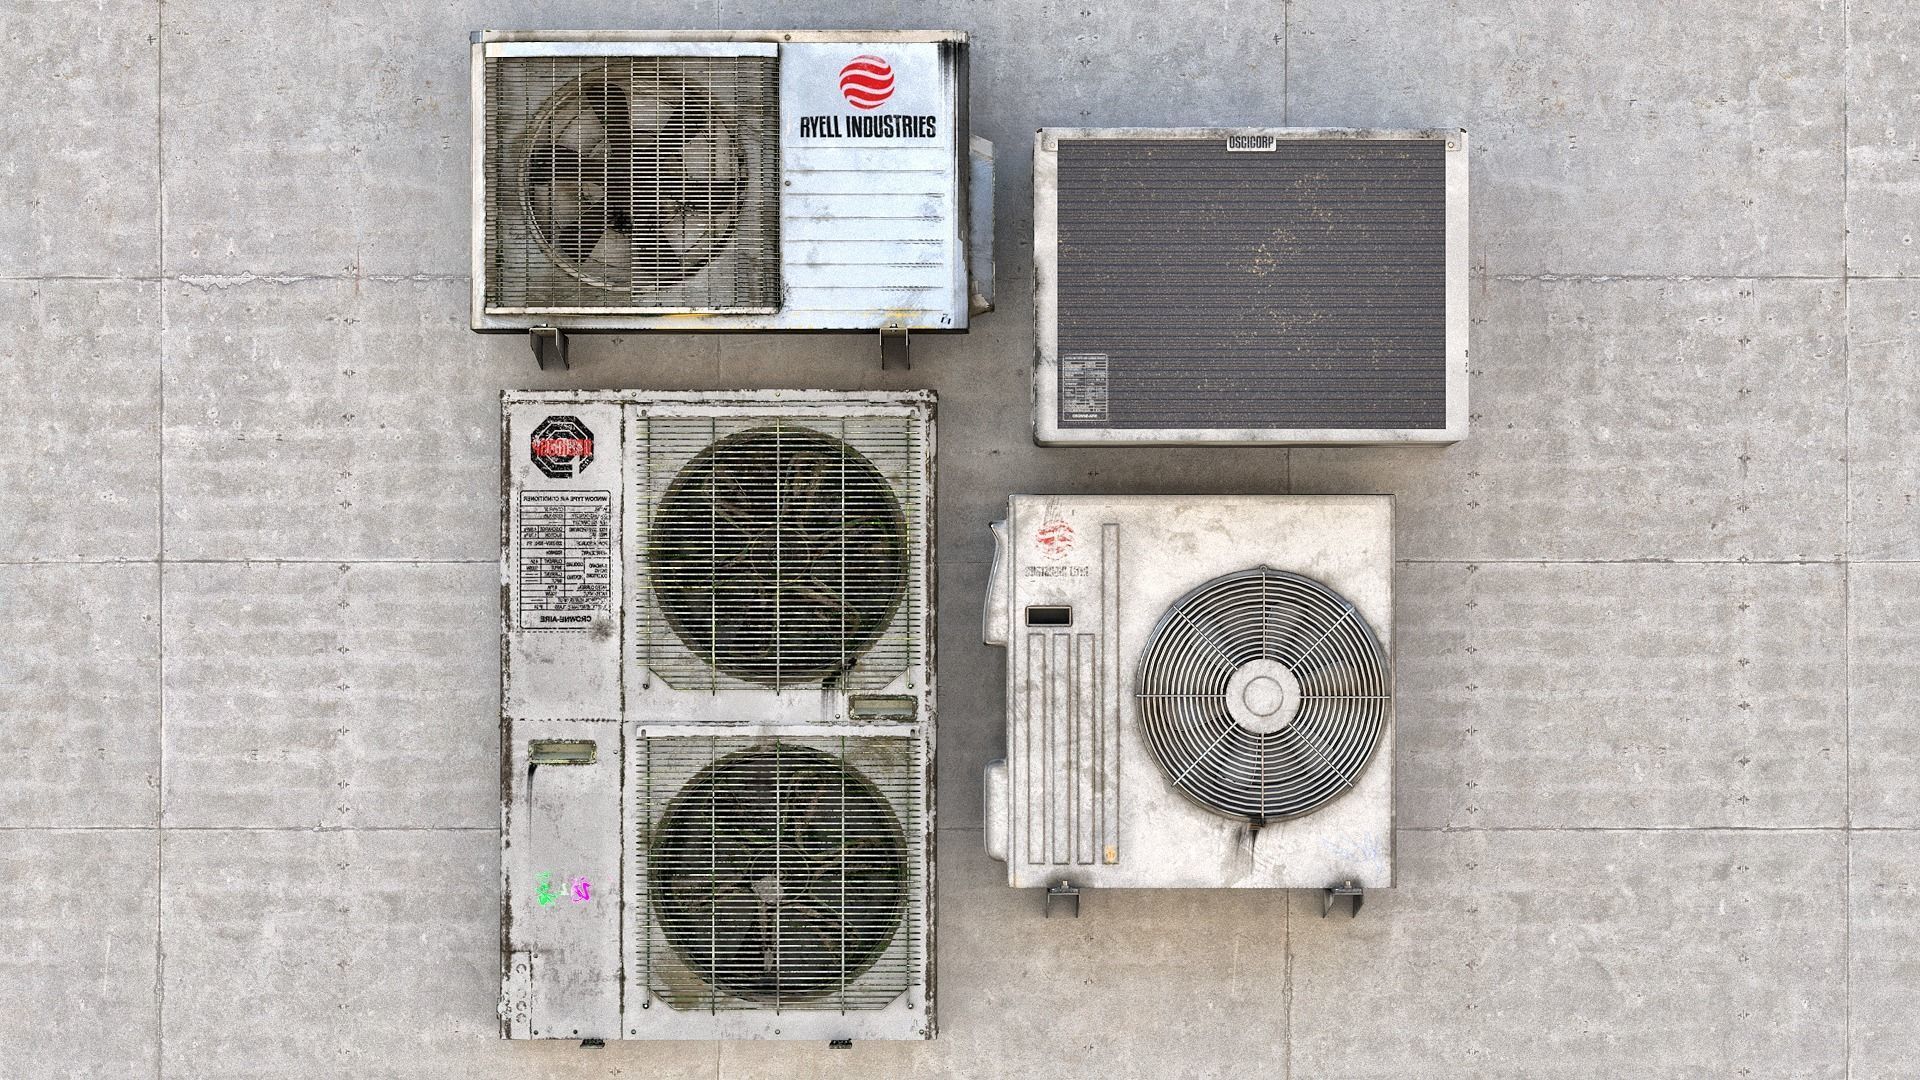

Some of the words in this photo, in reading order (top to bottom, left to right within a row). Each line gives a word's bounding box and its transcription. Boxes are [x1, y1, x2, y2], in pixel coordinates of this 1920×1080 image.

[800, 115, 842, 138] RYELL
[846, 114, 936, 138] INDUSTRIES
[1229, 135, 1274, 149] OSCICORP
